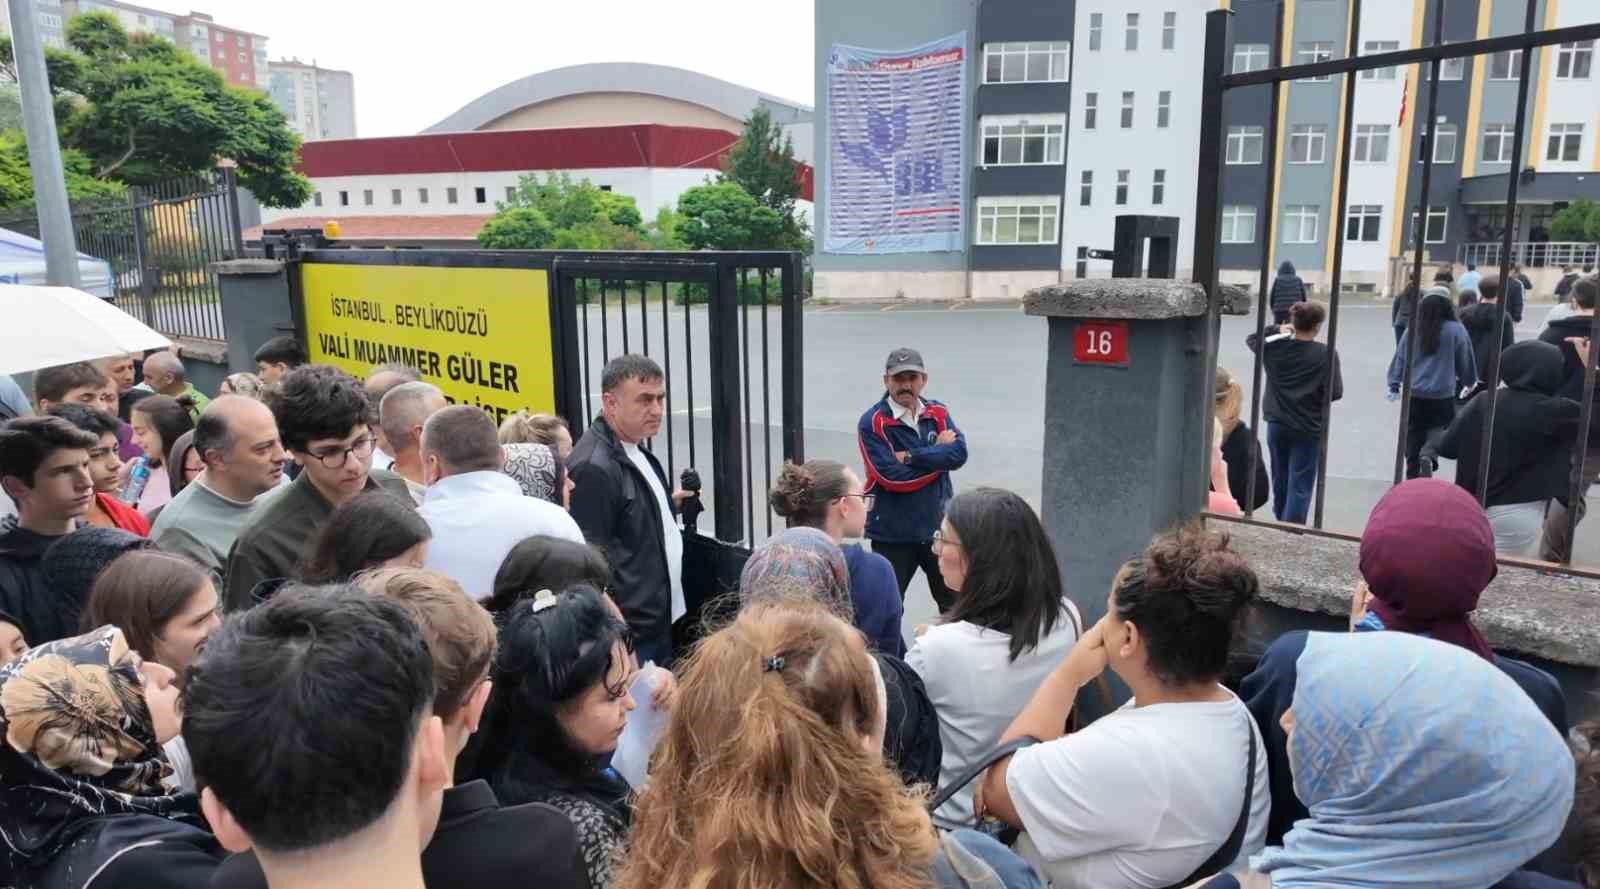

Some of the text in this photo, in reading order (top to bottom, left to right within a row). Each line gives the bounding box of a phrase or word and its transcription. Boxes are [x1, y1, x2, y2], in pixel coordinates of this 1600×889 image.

[330, 294, 385, 323] İSTANBUL
[396, 304, 488, 336] BEYLİKDÜZÜ
[319, 332, 520, 392] VALİ MUAMMER GÜLER
[1087, 330, 1112, 355] 16
